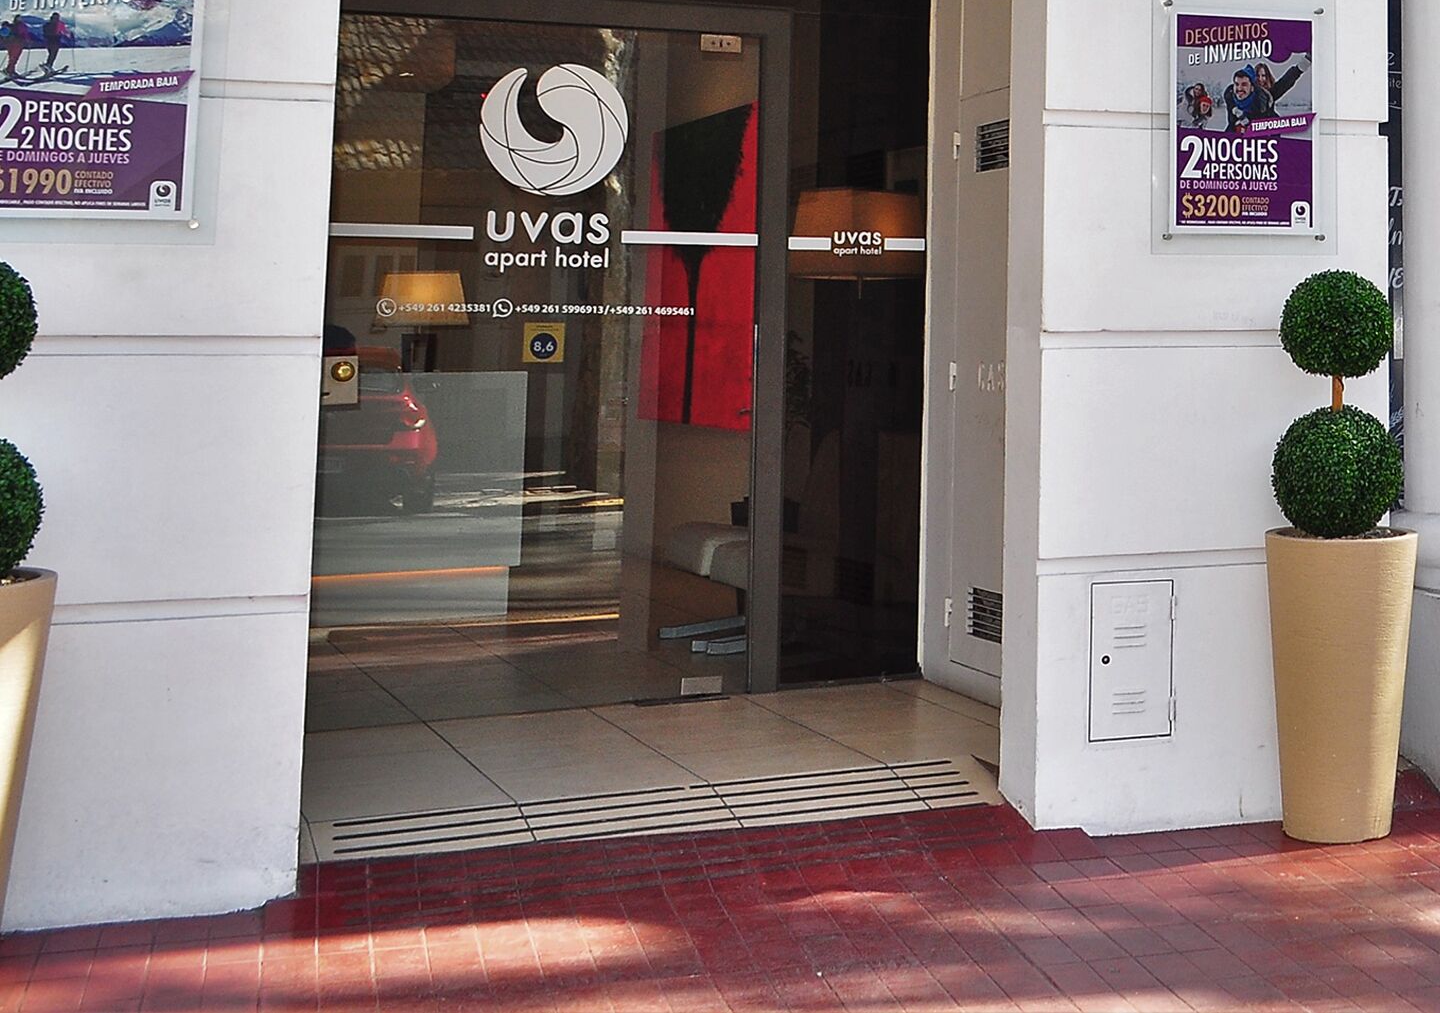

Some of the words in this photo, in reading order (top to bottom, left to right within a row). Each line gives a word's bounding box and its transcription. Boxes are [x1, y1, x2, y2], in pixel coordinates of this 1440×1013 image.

[1185, 22, 1268, 46] DESCUENTOS
[1189, 53, 1200, 65] DE
[1204, 40, 1272, 63] INVIERNO
[100, 78, 154, 92] TEMPORADA
[156, 76, 178, 88] BAJA
[24, 101, 134, 126] PERSONAS
[1252, 119, 1289, 131] TEMPORADA
[21, 129, 35, 149] 2
[41, 128, 132, 152] NOCHES
[7, 151, 74, 162] DOMINGOS
[77, 153, 85, 163] A
[88, 153, 129, 164] JUEVES
[1181, 136, 1203, 178] 2
[1203, 138, 1278, 163] NOCHES
[75, 171, 113, 179] CONTADO
[74, 180, 111, 188] EFECTIVO
[1180, 179, 1192, 189] DE
[1193, 180, 1239, 190] DOMINGOS
[1241, 181, 1247, 190] A
[1249, 181, 1277, 191] JUEVES
[1182, 193, 1240, 218] $3200
[487, 211, 609, 244] uvas
[834, 231, 882, 245] uvas
[833, 246, 858, 256] apart
[860, 247, 881, 255] hotel
[485, 250, 547, 273] apart
[555, 246, 609, 268] hotel
[399, 304, 425, 312] +549
[427, 303, 445, 312] 261
[448, 304, 491, 312] 4235381
[515, 305, 540, 313] +549
[542, 305, 560, 313] 261
[636, 306, 652, 314] 261
[655, 307, 695, 315] 4695461
[533, 341, 554, 353] 8,6
